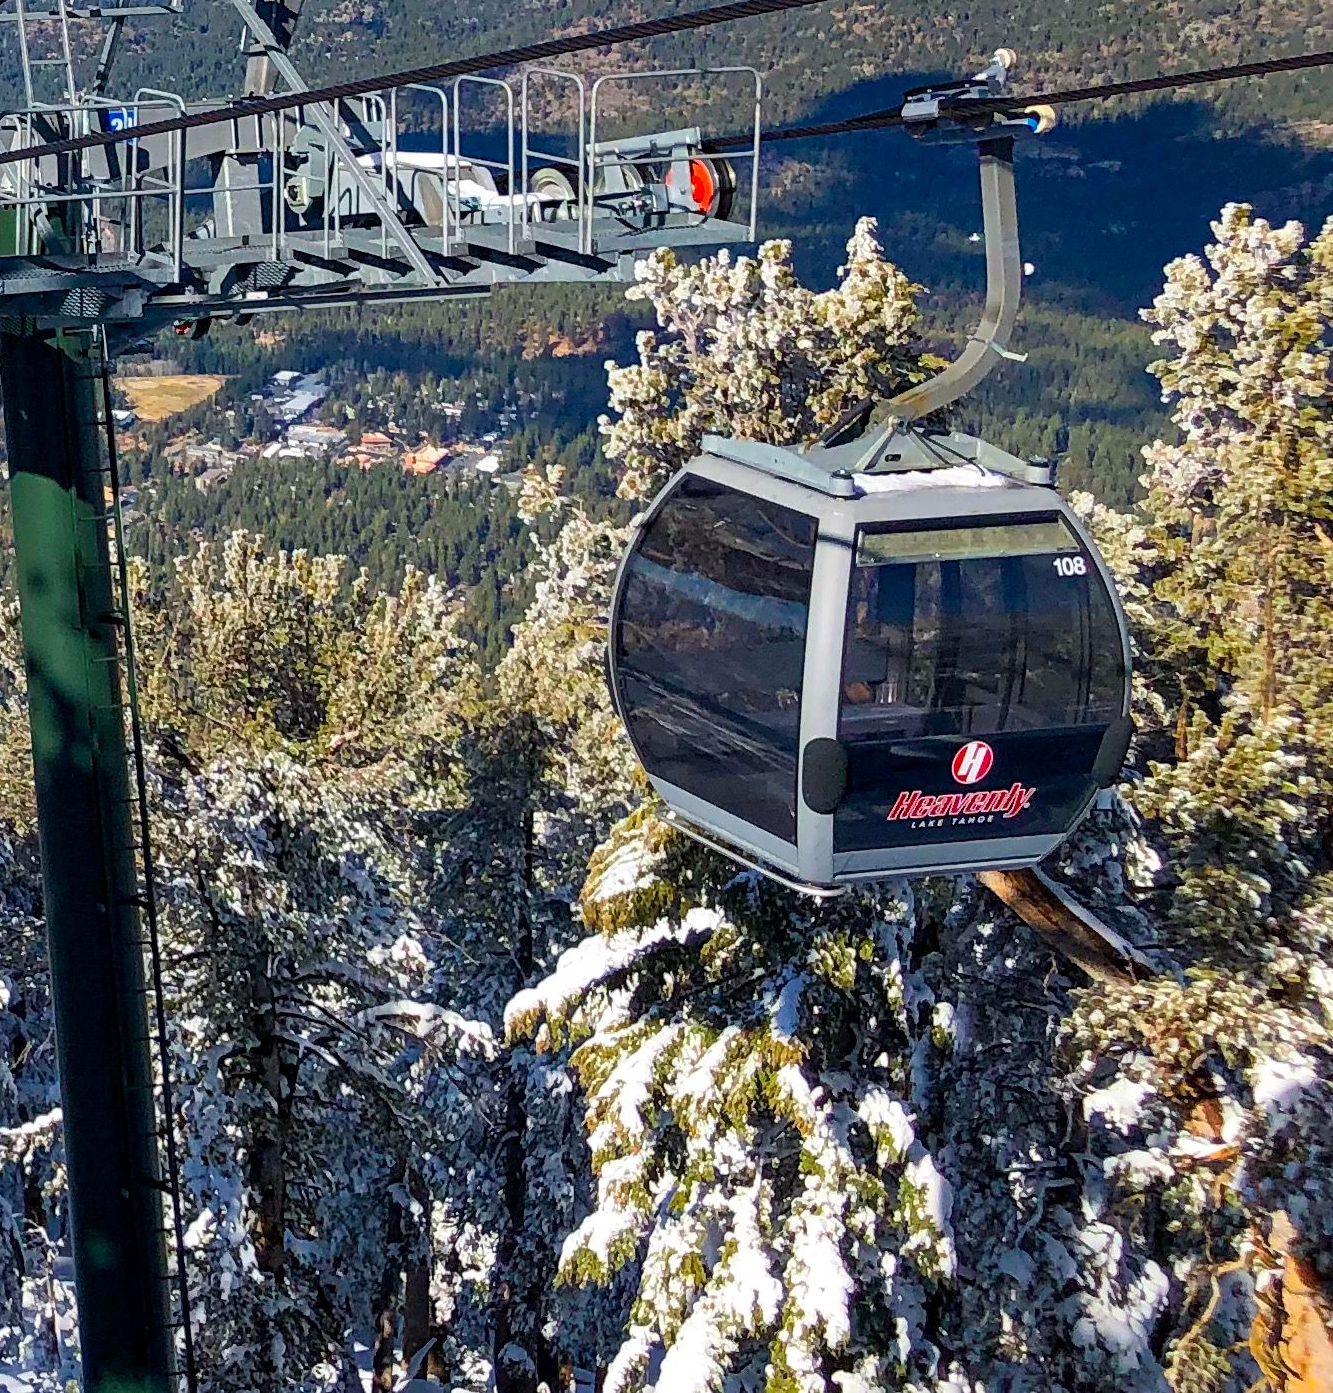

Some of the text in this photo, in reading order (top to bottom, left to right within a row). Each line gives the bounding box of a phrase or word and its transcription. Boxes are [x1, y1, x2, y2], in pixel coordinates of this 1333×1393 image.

[1053, 556, 1086, 576] 108
[887, 782, 1036, 820] Heavenly
[911, 814, 994, 829] LAKE TAHOE
